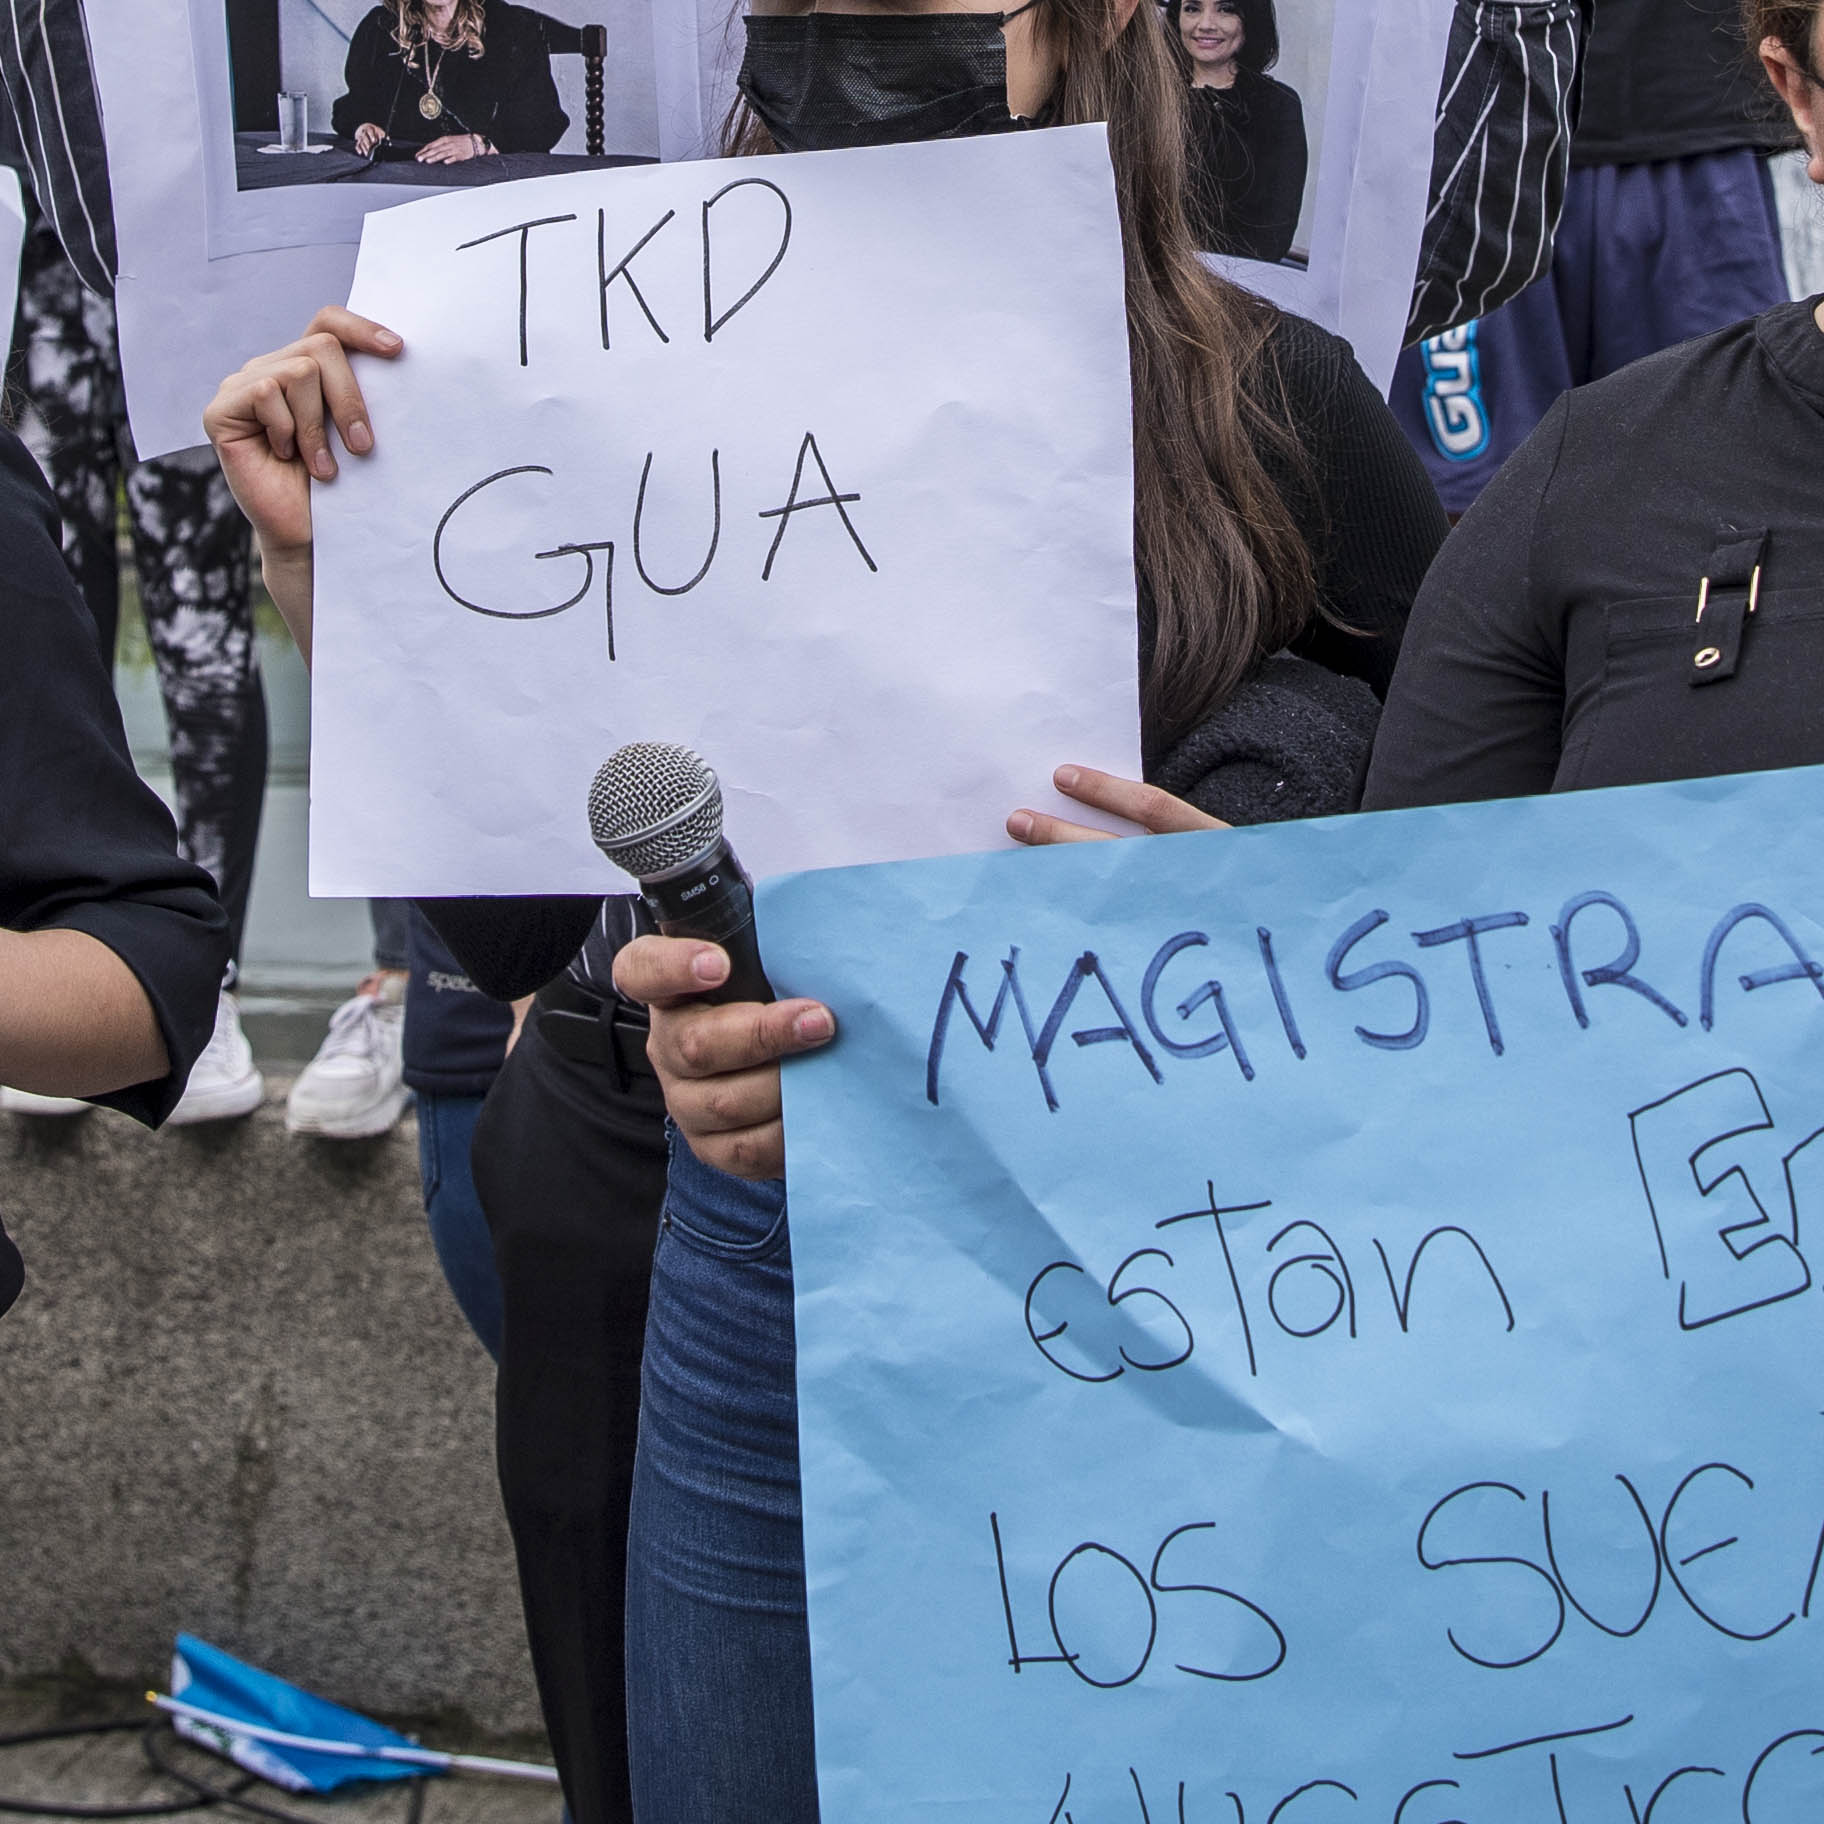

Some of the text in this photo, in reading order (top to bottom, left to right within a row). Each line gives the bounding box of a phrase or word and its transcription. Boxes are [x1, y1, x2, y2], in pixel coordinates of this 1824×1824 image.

[456, 176, 793, 368] TKD
[432, 432, 879, 663] GUA
[991, 1511, 1285, 1688] LOS
